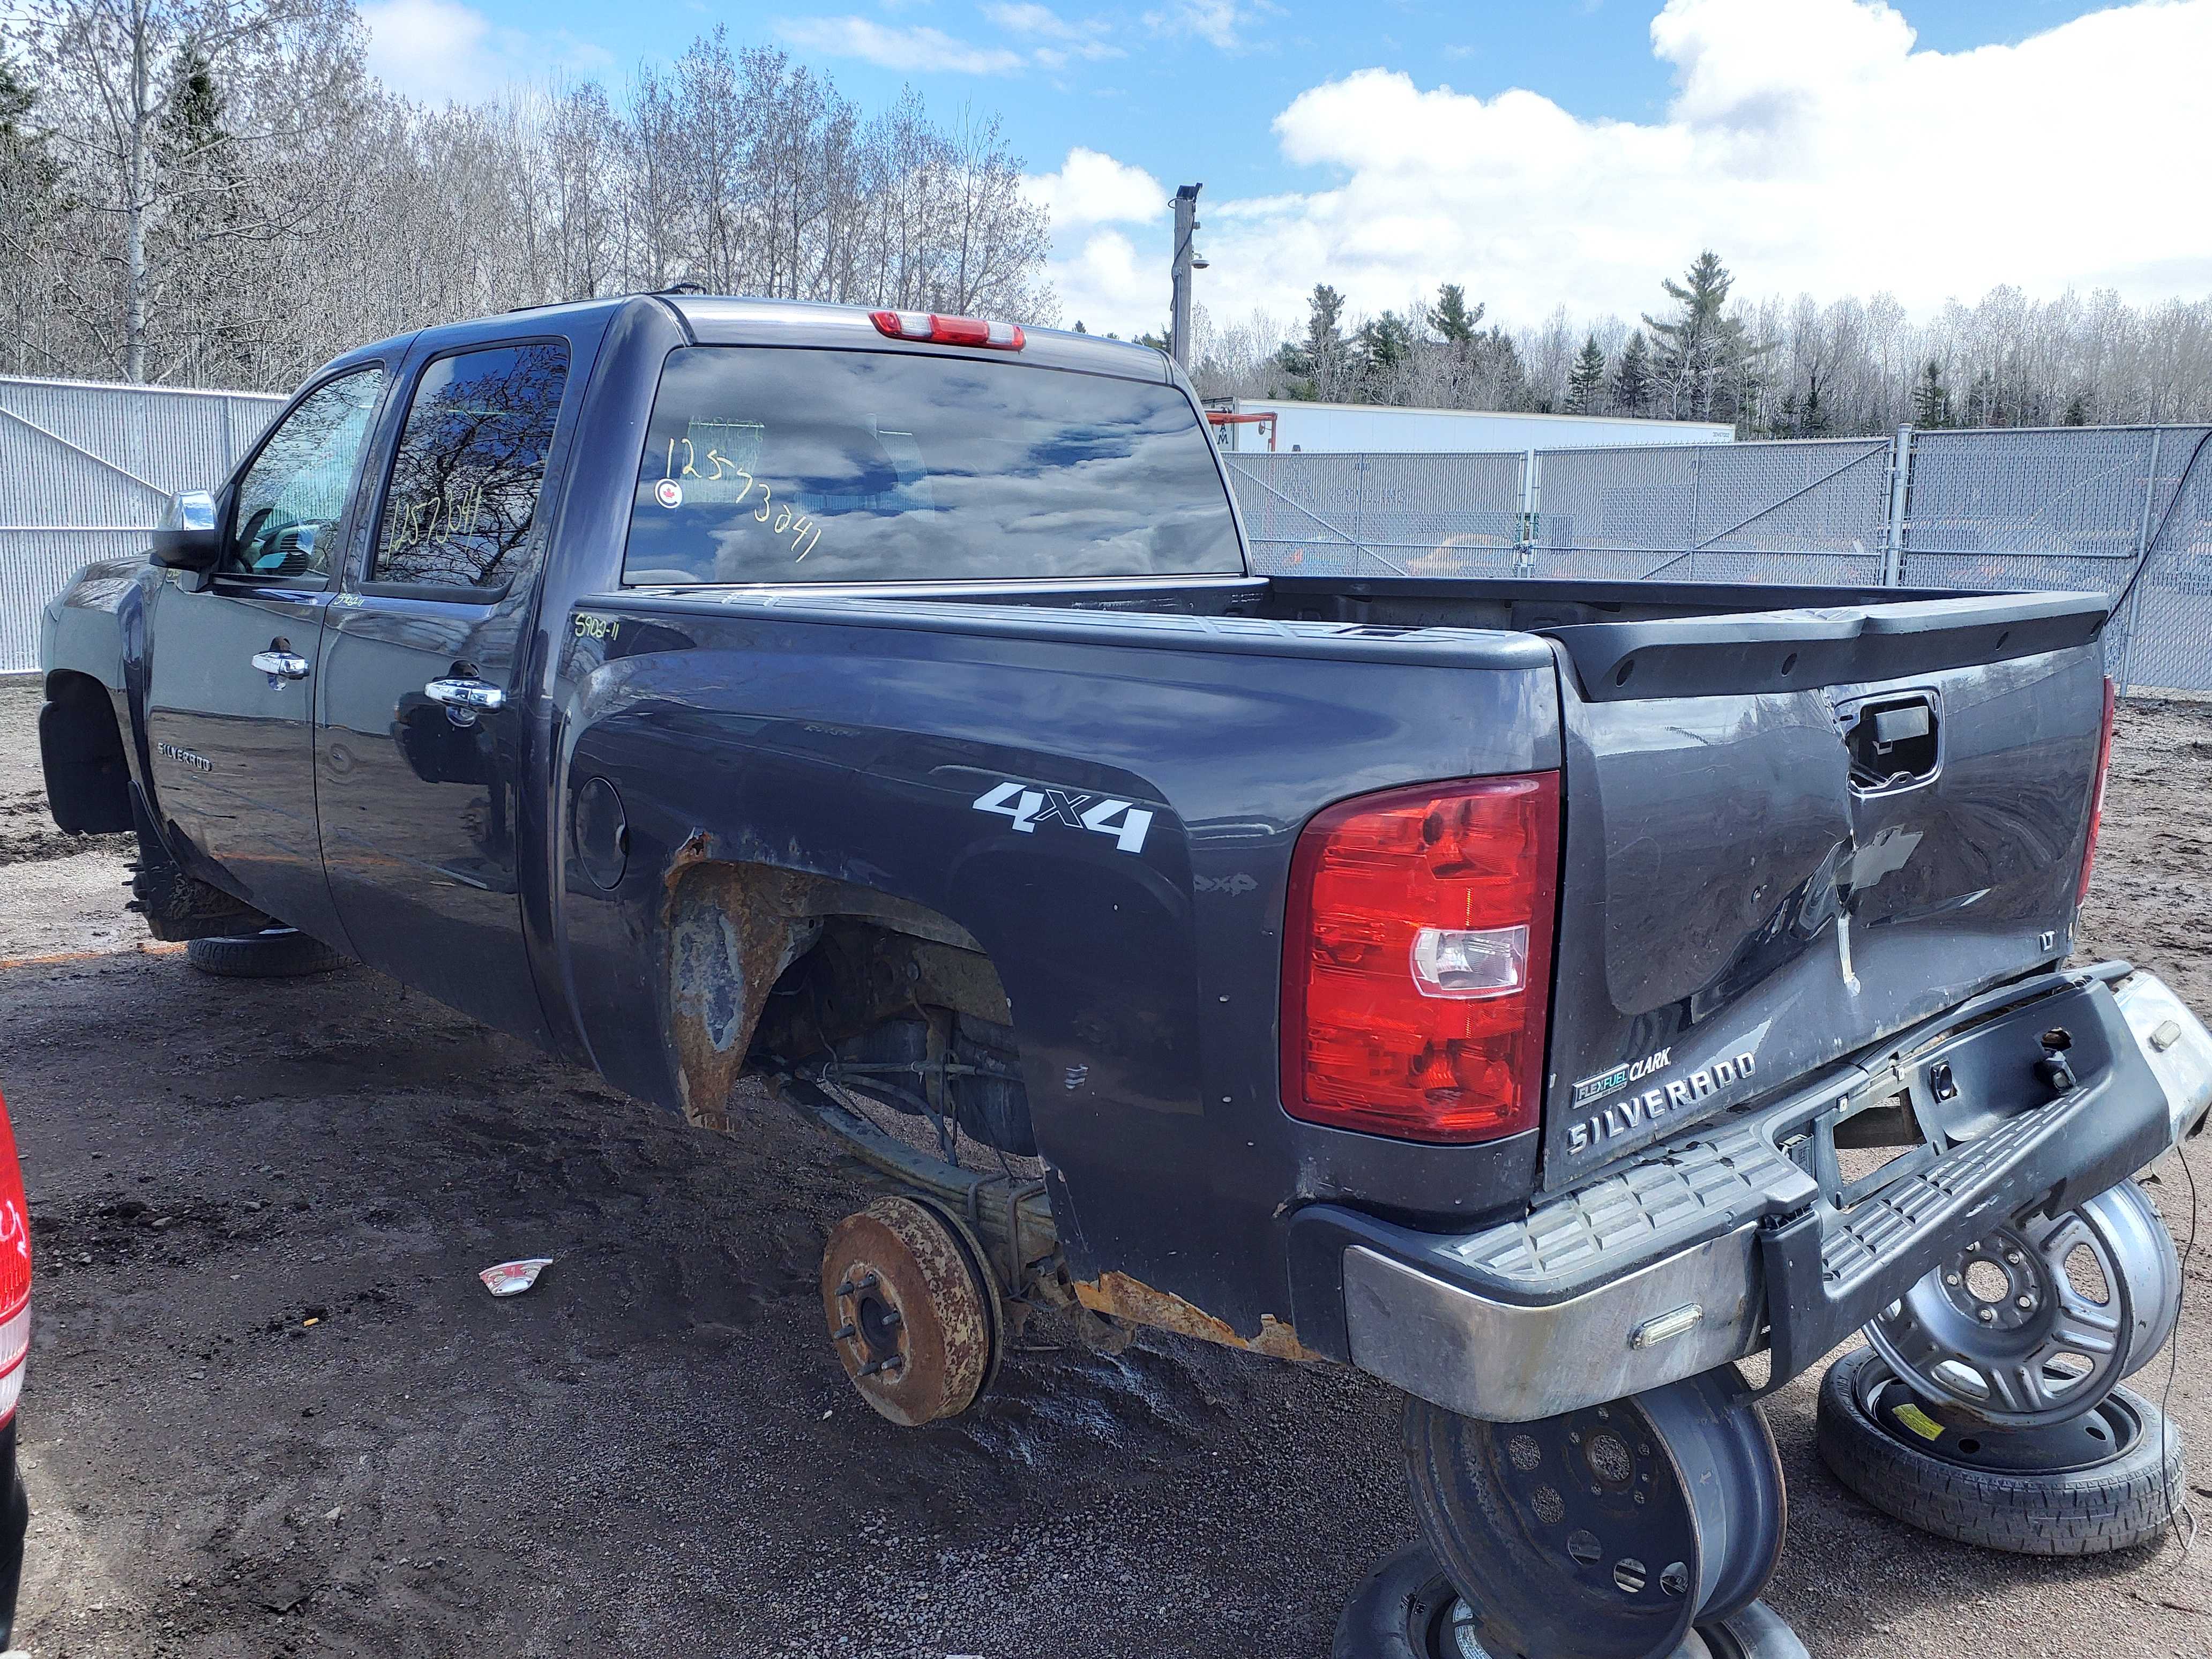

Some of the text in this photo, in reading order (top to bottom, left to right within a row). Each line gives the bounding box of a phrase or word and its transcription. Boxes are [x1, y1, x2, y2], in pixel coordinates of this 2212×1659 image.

[574, 613, 620, 641] 5902-11
[158, 742, 211, 772] SILVERADO
[2039, 930, 2056, 951] LT
[1579, 1046, 1671, 1100] FLEXFUEL CLARK
[1567, 1051, 1755, 1155] SILVERADO
